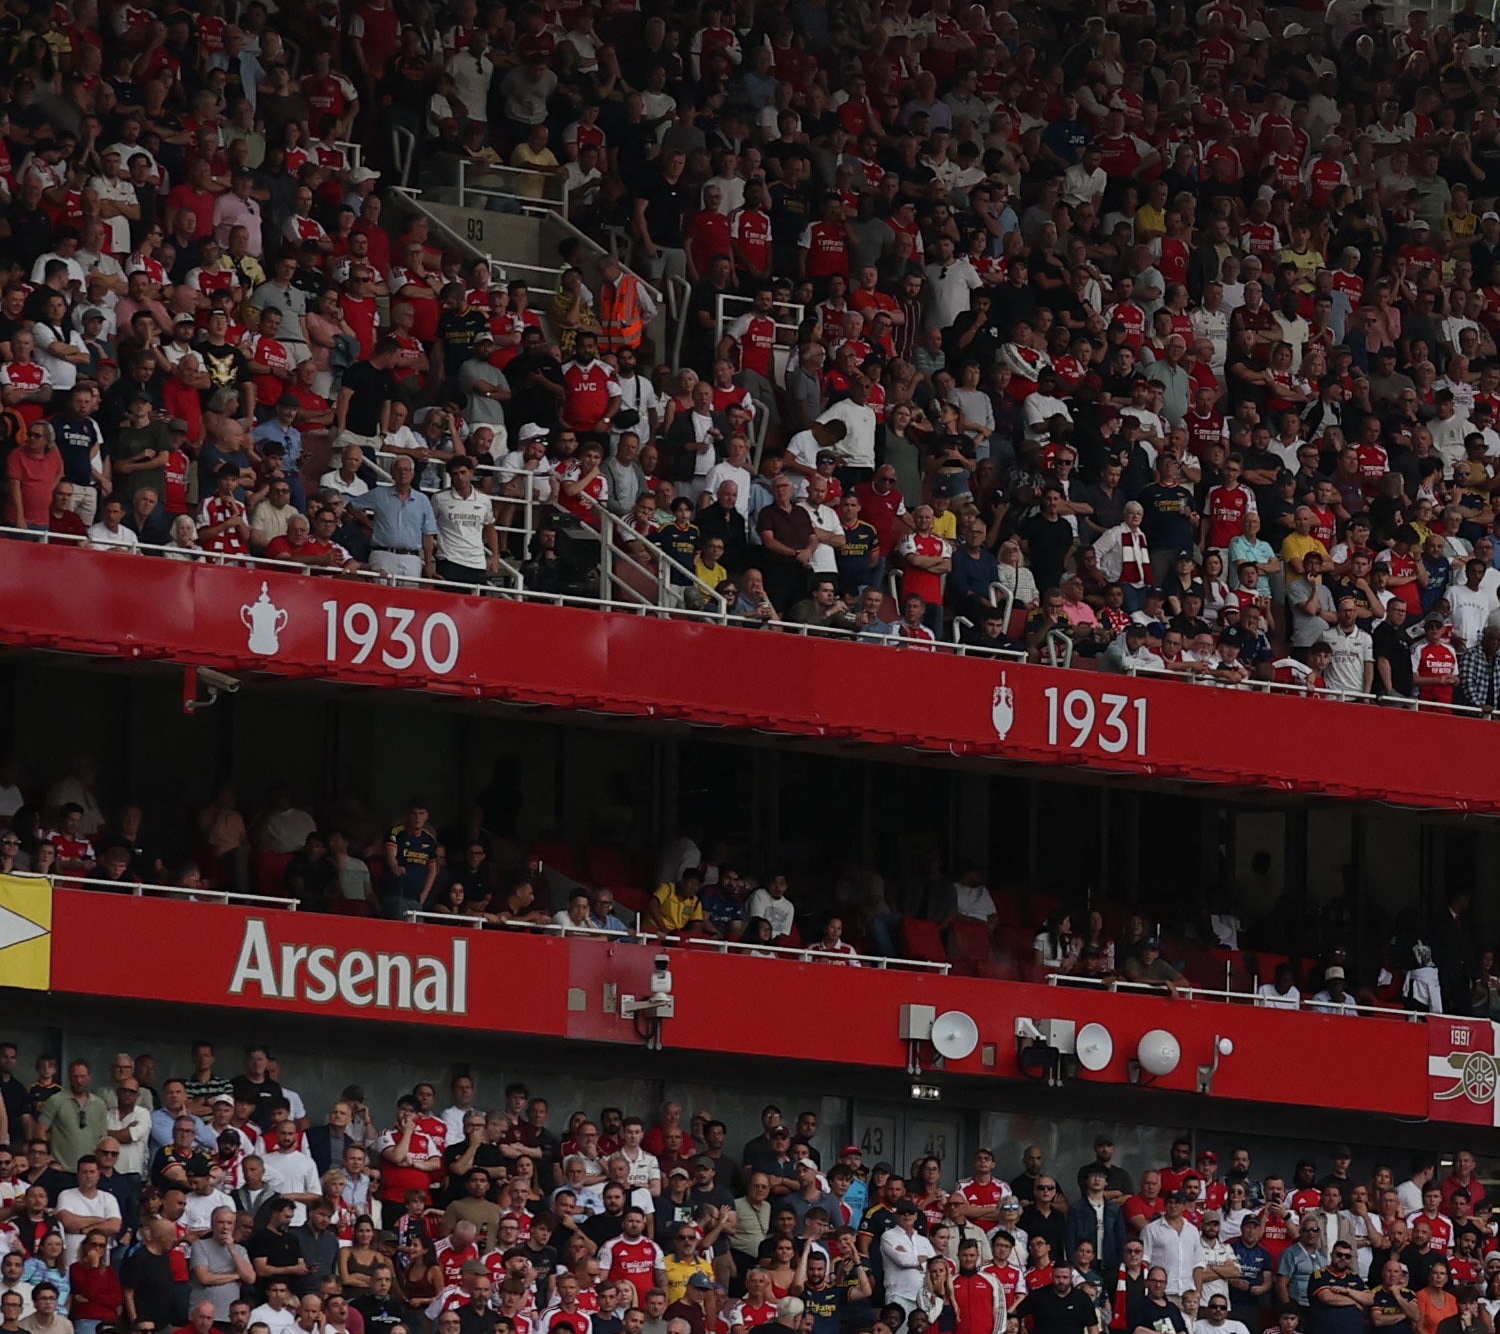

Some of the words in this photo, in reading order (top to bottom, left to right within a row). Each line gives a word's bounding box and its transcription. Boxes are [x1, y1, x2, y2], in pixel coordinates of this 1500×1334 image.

[467, 218, 484, 241] 93
[324, 599, 459, 674] 1930
[1044, 686, 1148, 756] 1931
[229, 916, 470, 1016] Arsenal
[1450, 1030, 1470, 1048] 1991
[861, 1127, 884, 1156] 43
